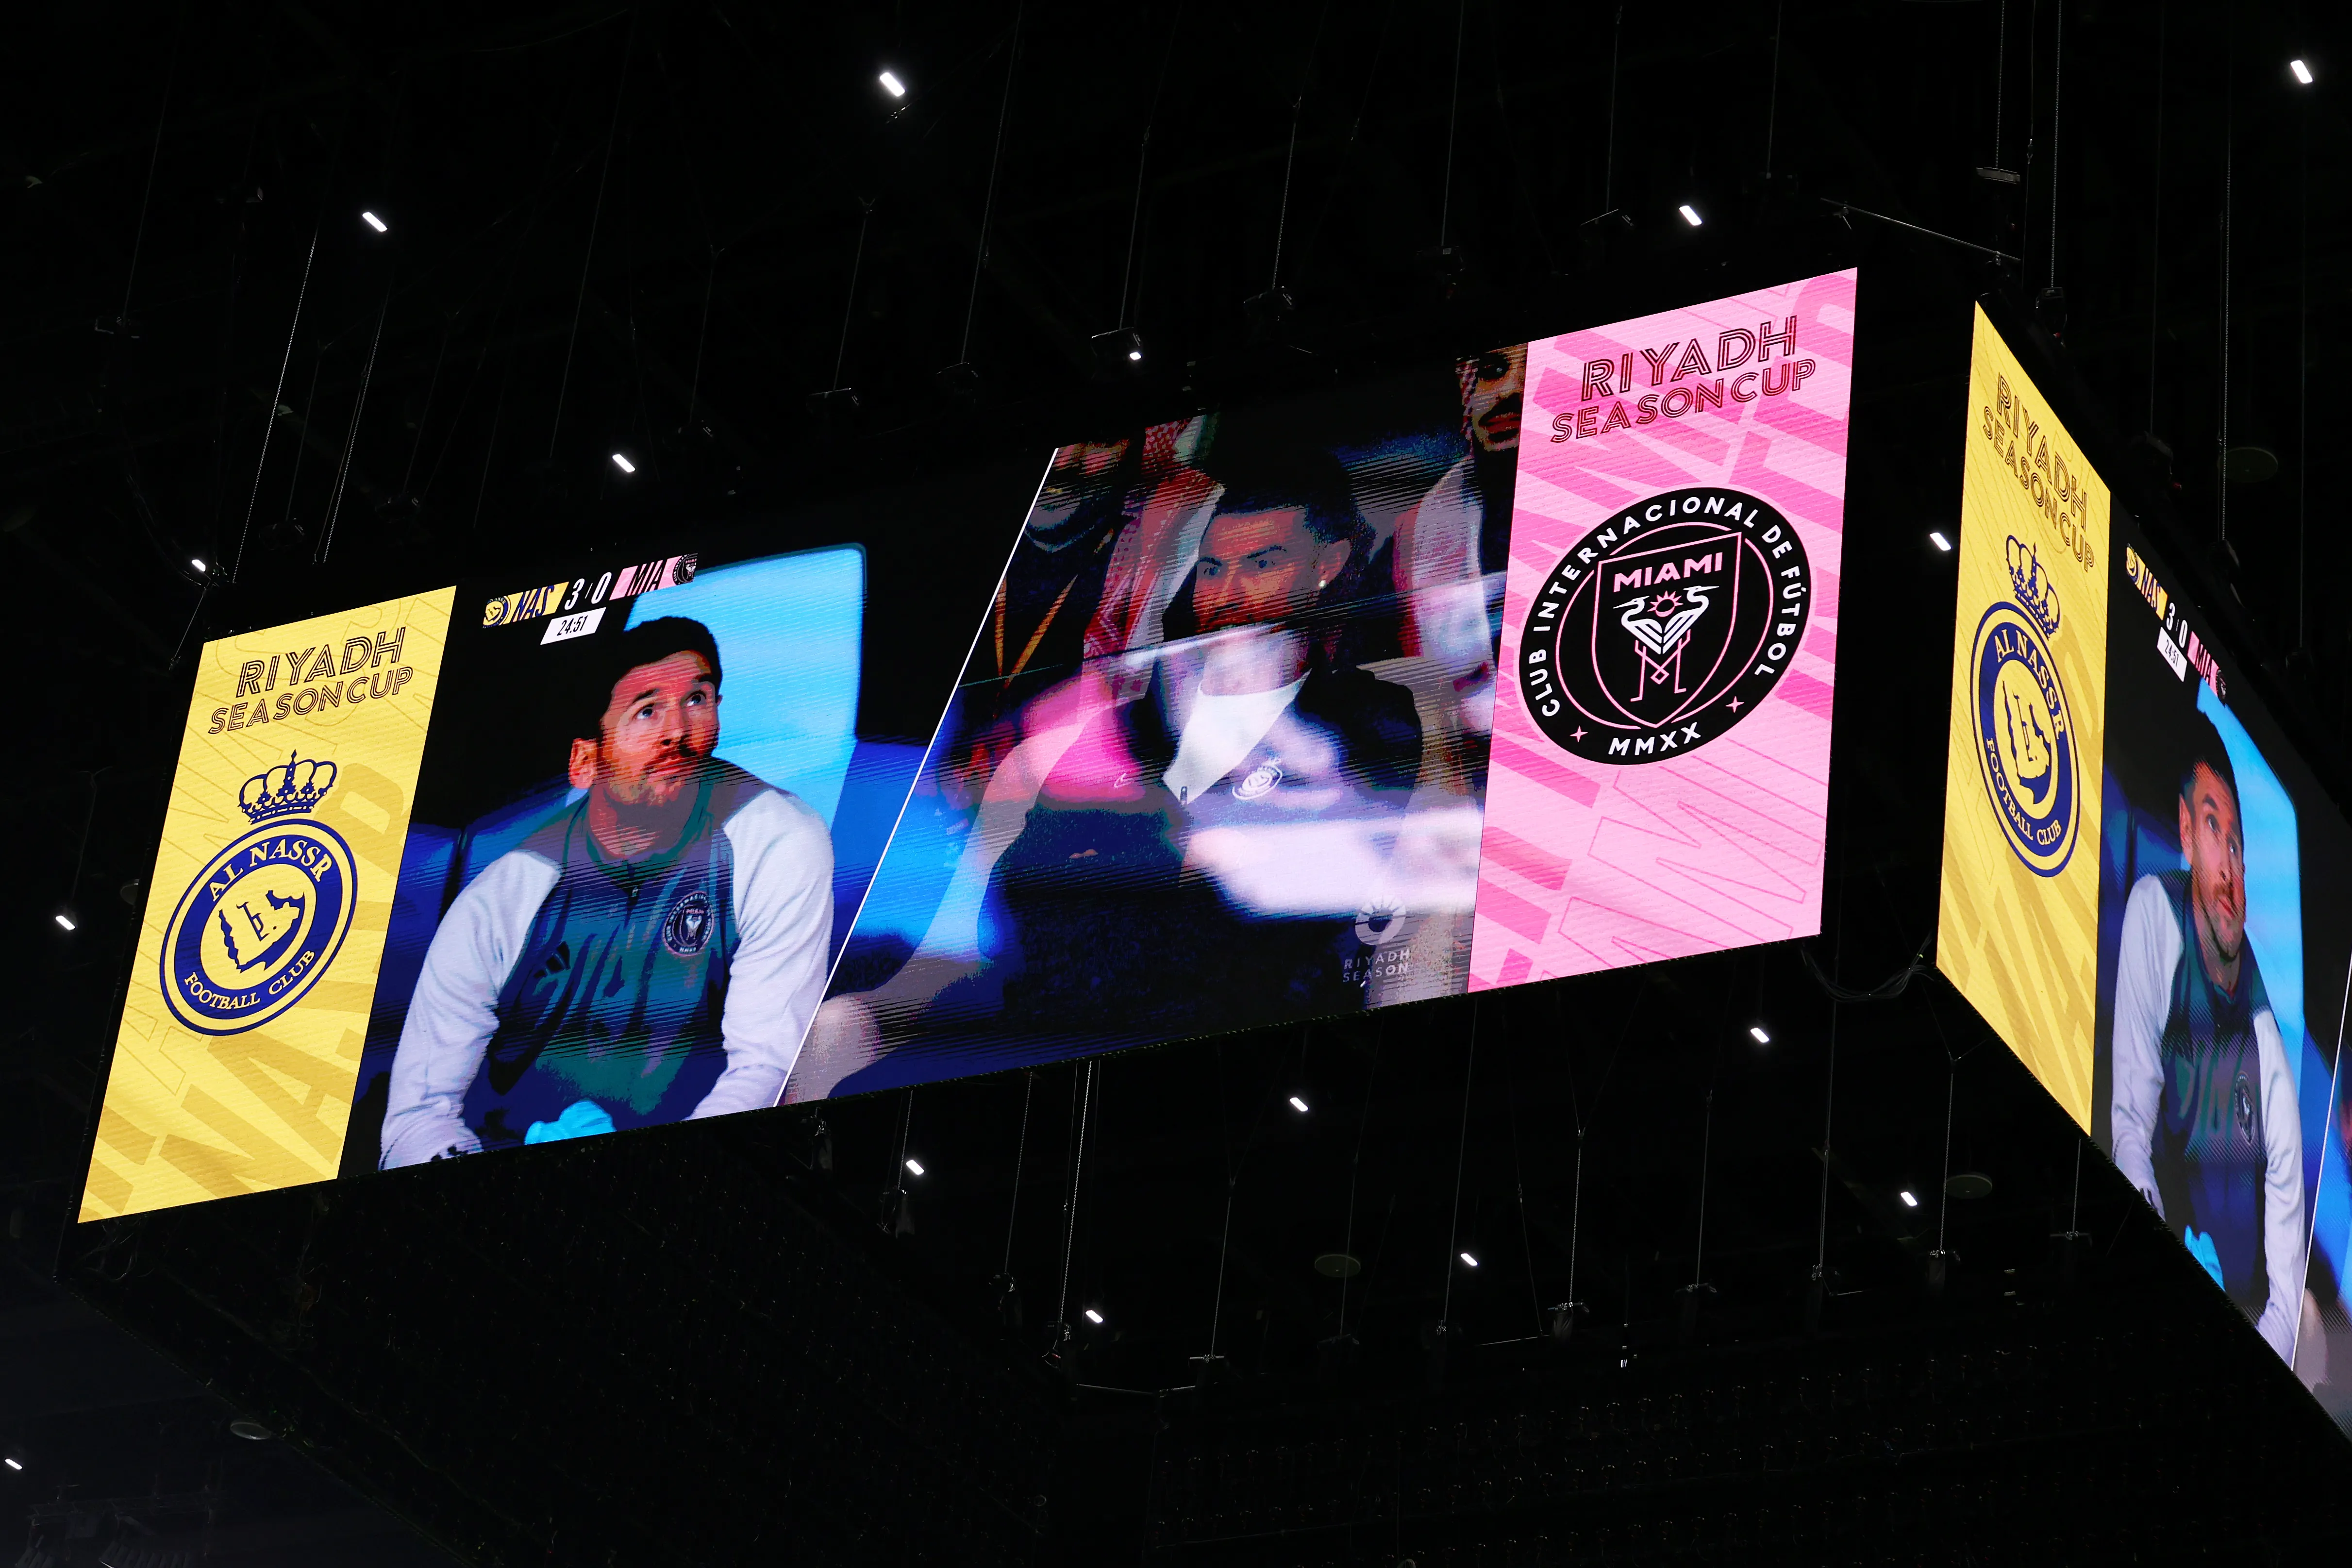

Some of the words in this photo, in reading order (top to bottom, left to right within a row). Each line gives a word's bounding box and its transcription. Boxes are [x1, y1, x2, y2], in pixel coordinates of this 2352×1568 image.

[1581, 315, 1797, 401] RIYADH
[1997, 372, 2087, 532] RIYADH
[1534, 497, 1759, 632] INTERNACIONAL
[1614, 552, 1723, 592] MIAMI
[1762, 525, 1793, 559] DE
[513, 585, 554, 622] NAS
[565, 578, 585, 610] 3
[591, 572, 612, 604] 0
[629, 560, 664, 596] MIA
[1754, 566, 1806, 675] FÚTBOL
[557, 616, 588, 636] 24:51
[2165, 639, 2179, 667] 24:51
[2166, 602, 2175, 630] 3
[2179, 619, 2188, 648] 0
[236, 627, 406, 698] RIYADH
[1529, 649, 1560, 717] CLUB
[1994, 629, 2014, 662] AL
[2015, 631, 2065, 740] NASSR
[1608, 722, 1701, 756] MMXX
[1986, 737, 2033, 840] FOOTBALL
[2037, 819, 2062, 845] CLUB
[209, 867, 243, 901] AL
[250, 839, 333, 882] NASSR
[184, 972, 260, 1009] FOOTBALL
[268, 951, 315, 995] CLUB
[1343, 963, 1408, 983] SEASON
[1344, 948, 1410, 969] RIYADH
